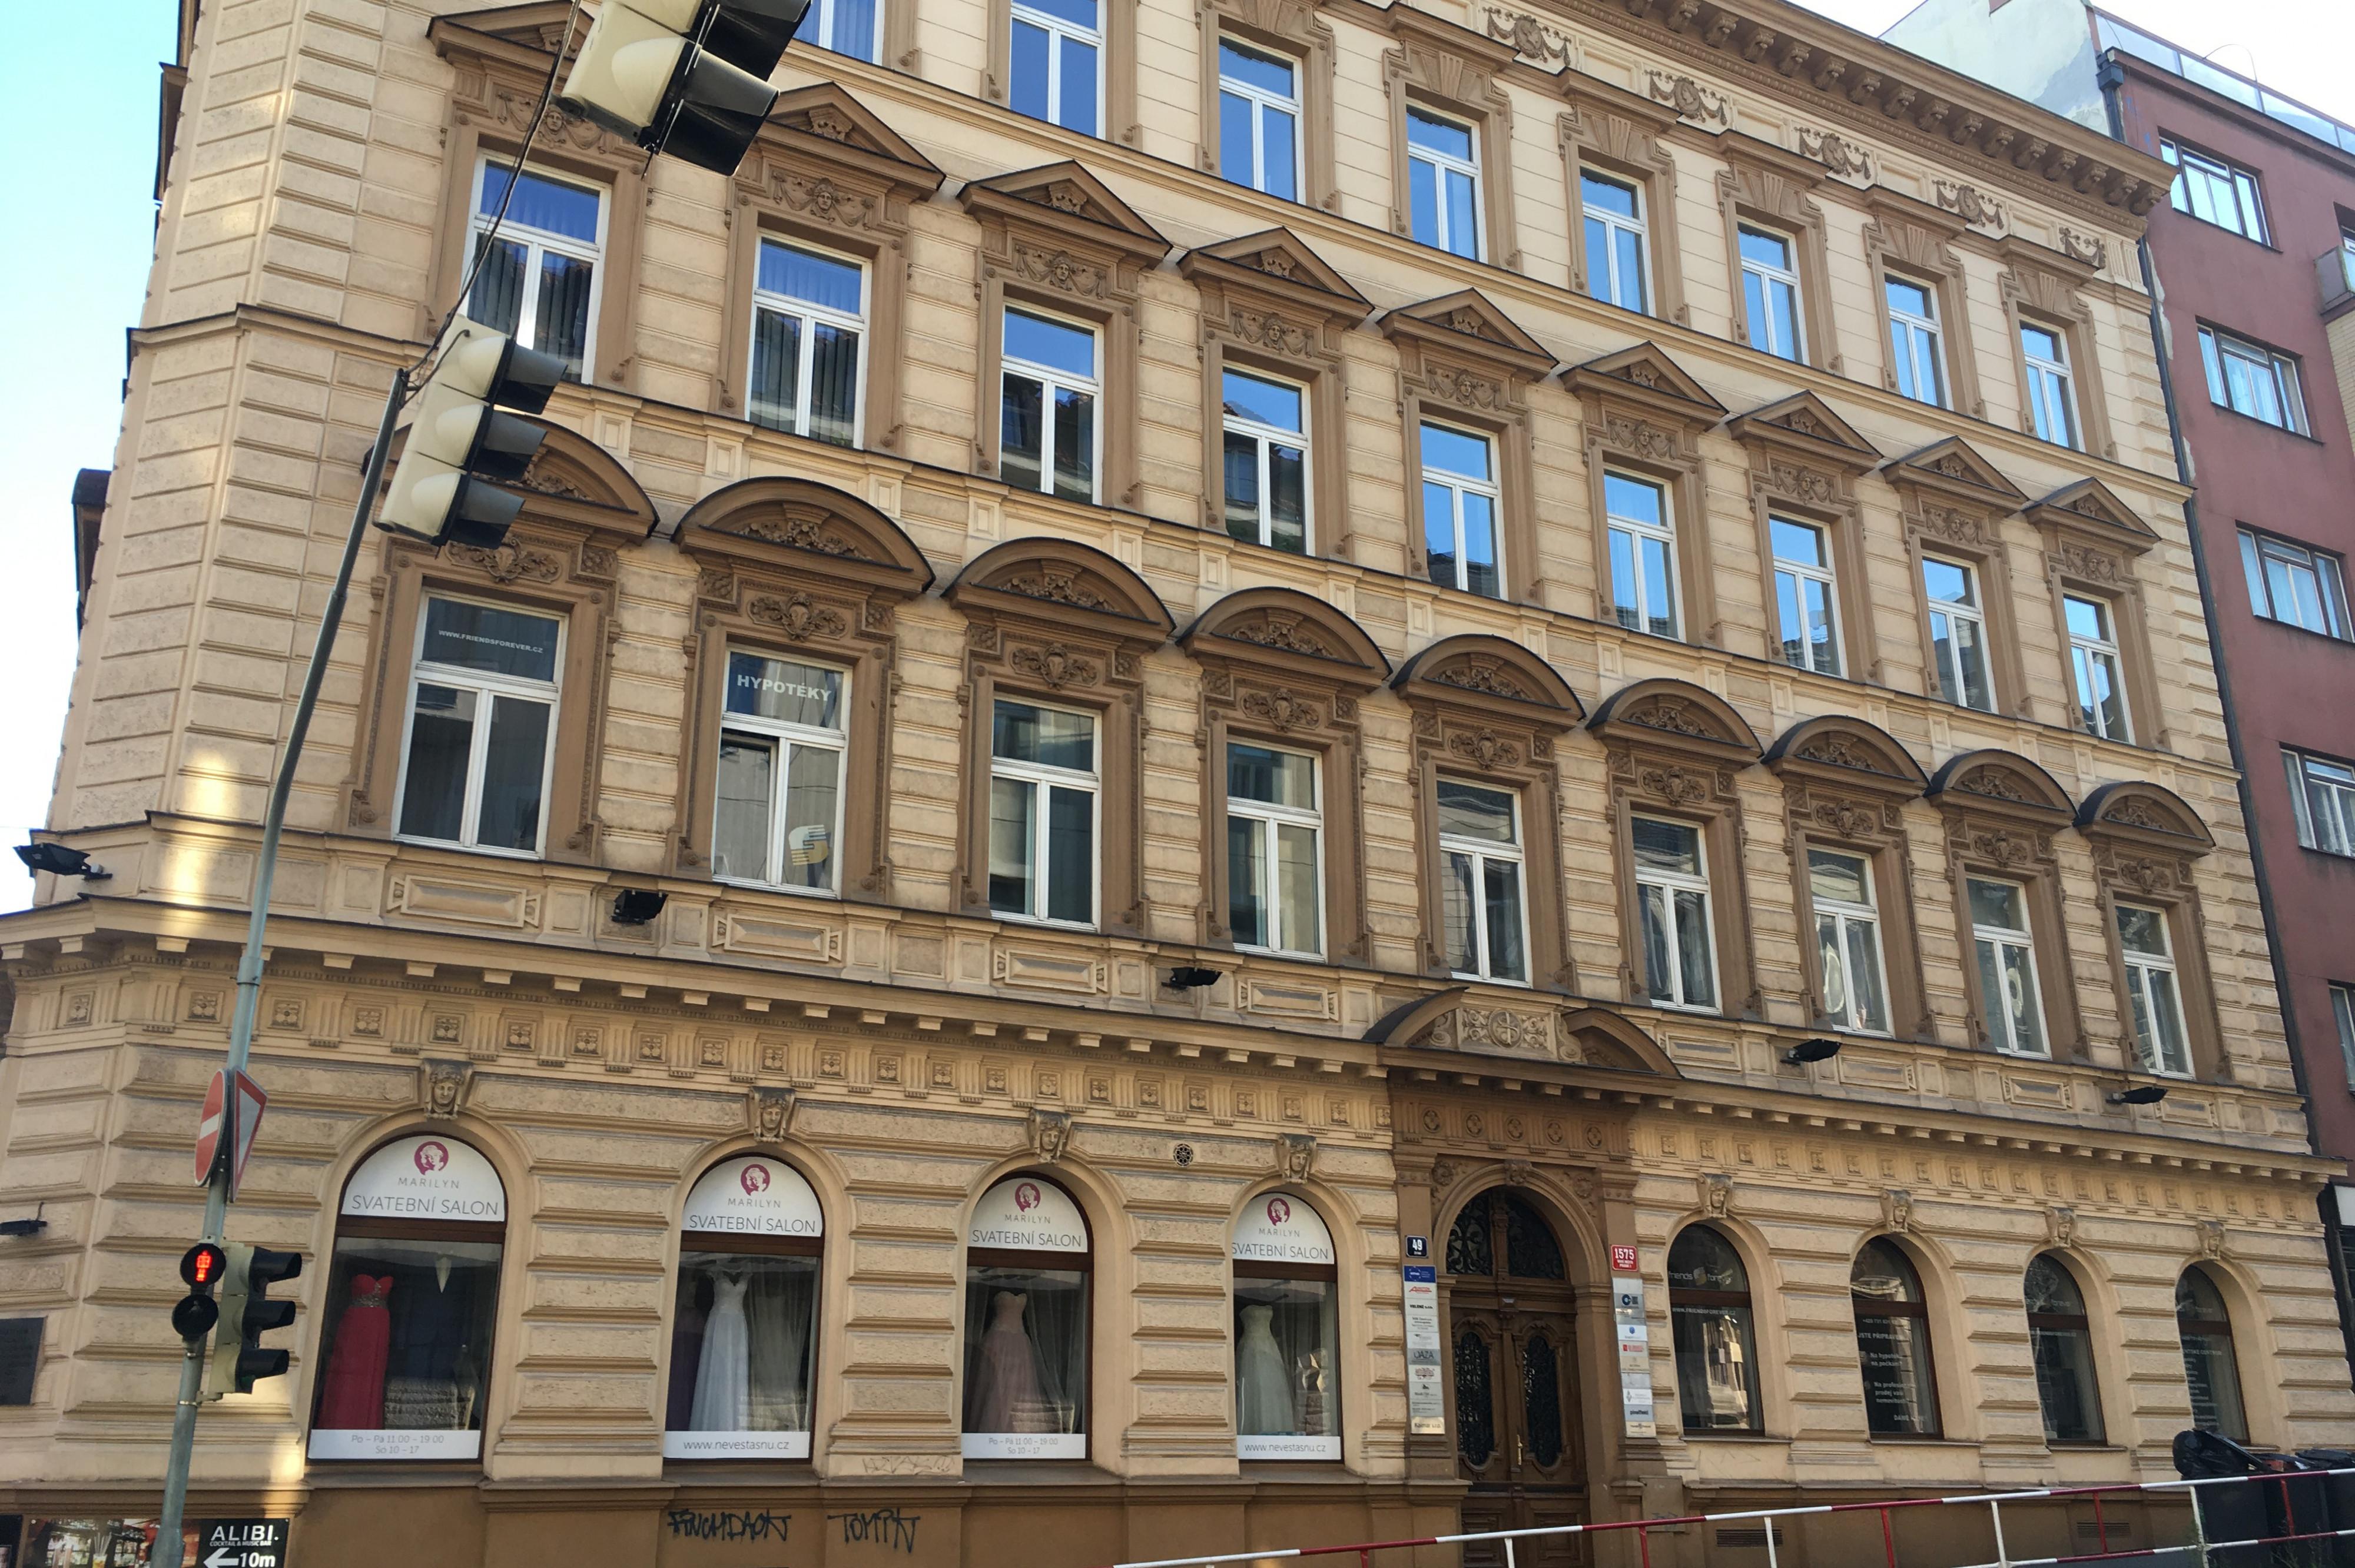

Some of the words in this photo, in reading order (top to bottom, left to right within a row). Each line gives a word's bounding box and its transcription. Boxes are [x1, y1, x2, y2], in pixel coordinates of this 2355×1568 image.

[438, 630, 543, 653] WWW.FRIENDSFOREVER.CZ
[737, 675, 831, 702] HYPOTÉKY
[398, 1177, 460, 1189] MARILYN
[351, 1195, 436, 1212] SVATEBNÍ
[441, 1199, 498, 1215] SALON
[728, 1198, 781, 1208] MARILYN
[689, 1215, 761, 1230] SVATEBNÍ
[767, 1218, 815, 1233] SALON
[1004, 1214, 1051, 1224] MARILYN
[972, 1230, 1034, 1245] SVATEBNÍ
[1039, 1233, 1082, 1247] SALON
[1259, 1228, 1300, 1237] MARILYN
[1412, 1239, 1422, 1251] 49
[1232, 1243, 1286, 1257] SVATEBNÍ
[1291, 1246, 1328, 1260] SALON
[1614, 1248, 1634, 1260] 1575
[351, 1435, 363, 1443] Po
[683, 1440, 790, 1450] www.nevestasnu.cz
[375, 1446, 387, 1454] So
[389, 1446, 400, 1454] 10
[409, 1446, 419, 1454] 17
[1244, 1444, 1326, 1452] www.nevestasnu.cz
[240, 1552, 276, 1567] 10m
